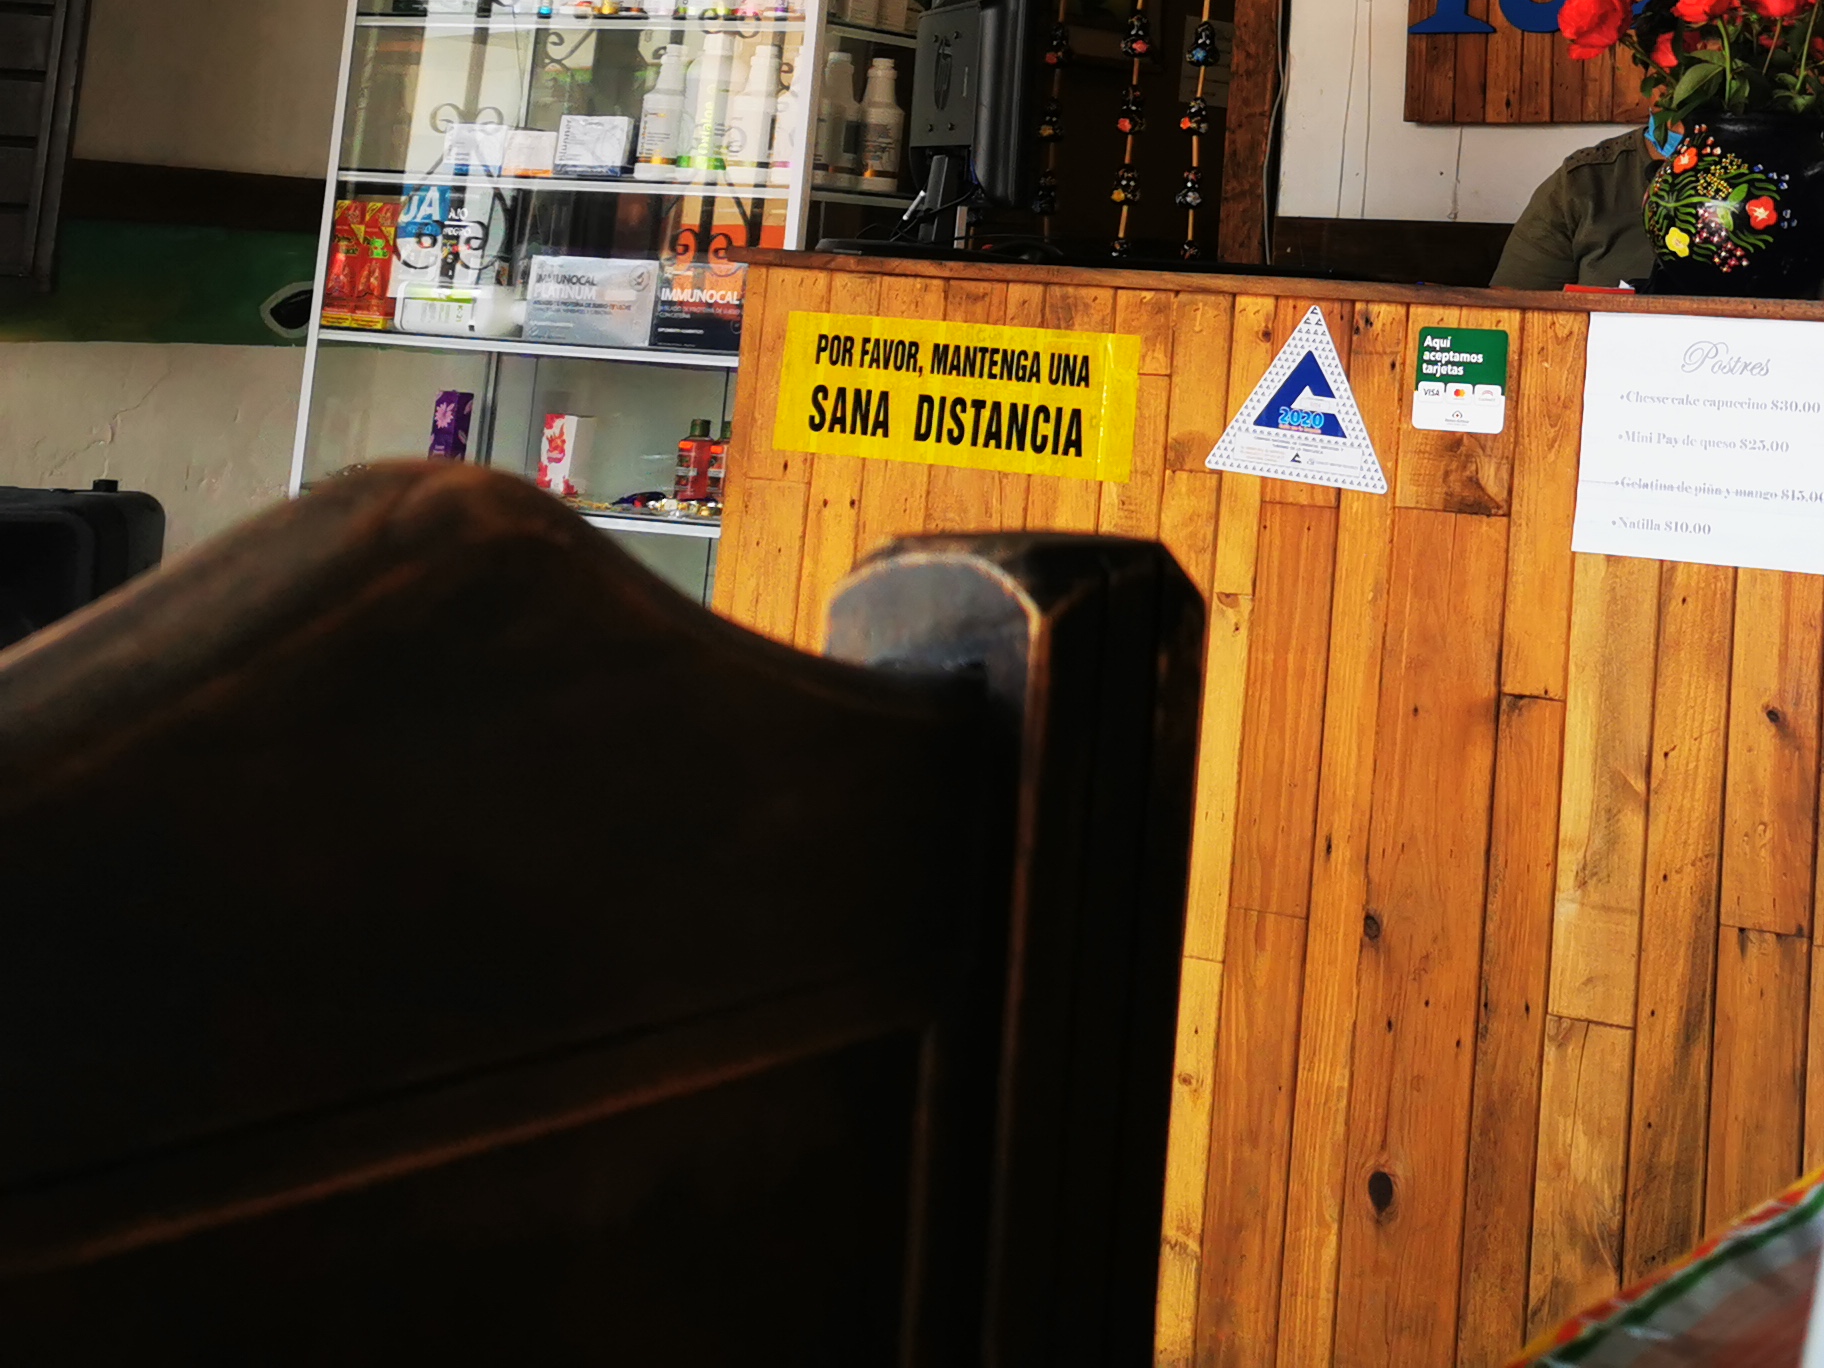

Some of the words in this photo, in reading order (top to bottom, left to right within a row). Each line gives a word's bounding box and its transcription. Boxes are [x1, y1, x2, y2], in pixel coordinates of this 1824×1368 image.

[536, 272, 597, 287] IMMUNOCAL
[533, 285, 596, 300] PLATINUM
[661, 287, 740, 305] IMMUNOCAL
[1424, 335, 1451, 350] Aquí
[815, 334, 853, 367] POR
[859, 337, 923, 377] FAVOR,
[930, 343, 1041, 383] MANTENGA
[1047, 352, 1090, 388] UNA
[1422, 351, 1484, 364] aceptamos
[1680, 340, 1771, 377] Postres
[1422, 363, 1464, 377] tarjetas
[1423, 388, 1440, 397] VISA
[1671, 393, 1699, 407] cake
[1770, 399, 1821, 414] $30.00
[808, 384, 890, 439] SANA
[914, 394, 1083, 458] DISTANCIA
[1278, 405, 1325, 429] 2020
[1624, 430, 1653, 444] Mini
[1656, 432, 1679, 448] Pay
[1682, 434, 1697, 447] de
[1700, 439, 1737, 451] queso
[1739, 438, 1790, 453] $25.00
[1621, 476, 1675, 491] Gelatina
[1676, 480, 1692, 494] de
[1694, 481, 1722, 497] piña
[1723, 488, 1731, 500] y
[1734, 487, 1778, 501] mango
[1618, 517, 1661, 532] Natilla
[1663, 521, 1712, 535] $10.00
